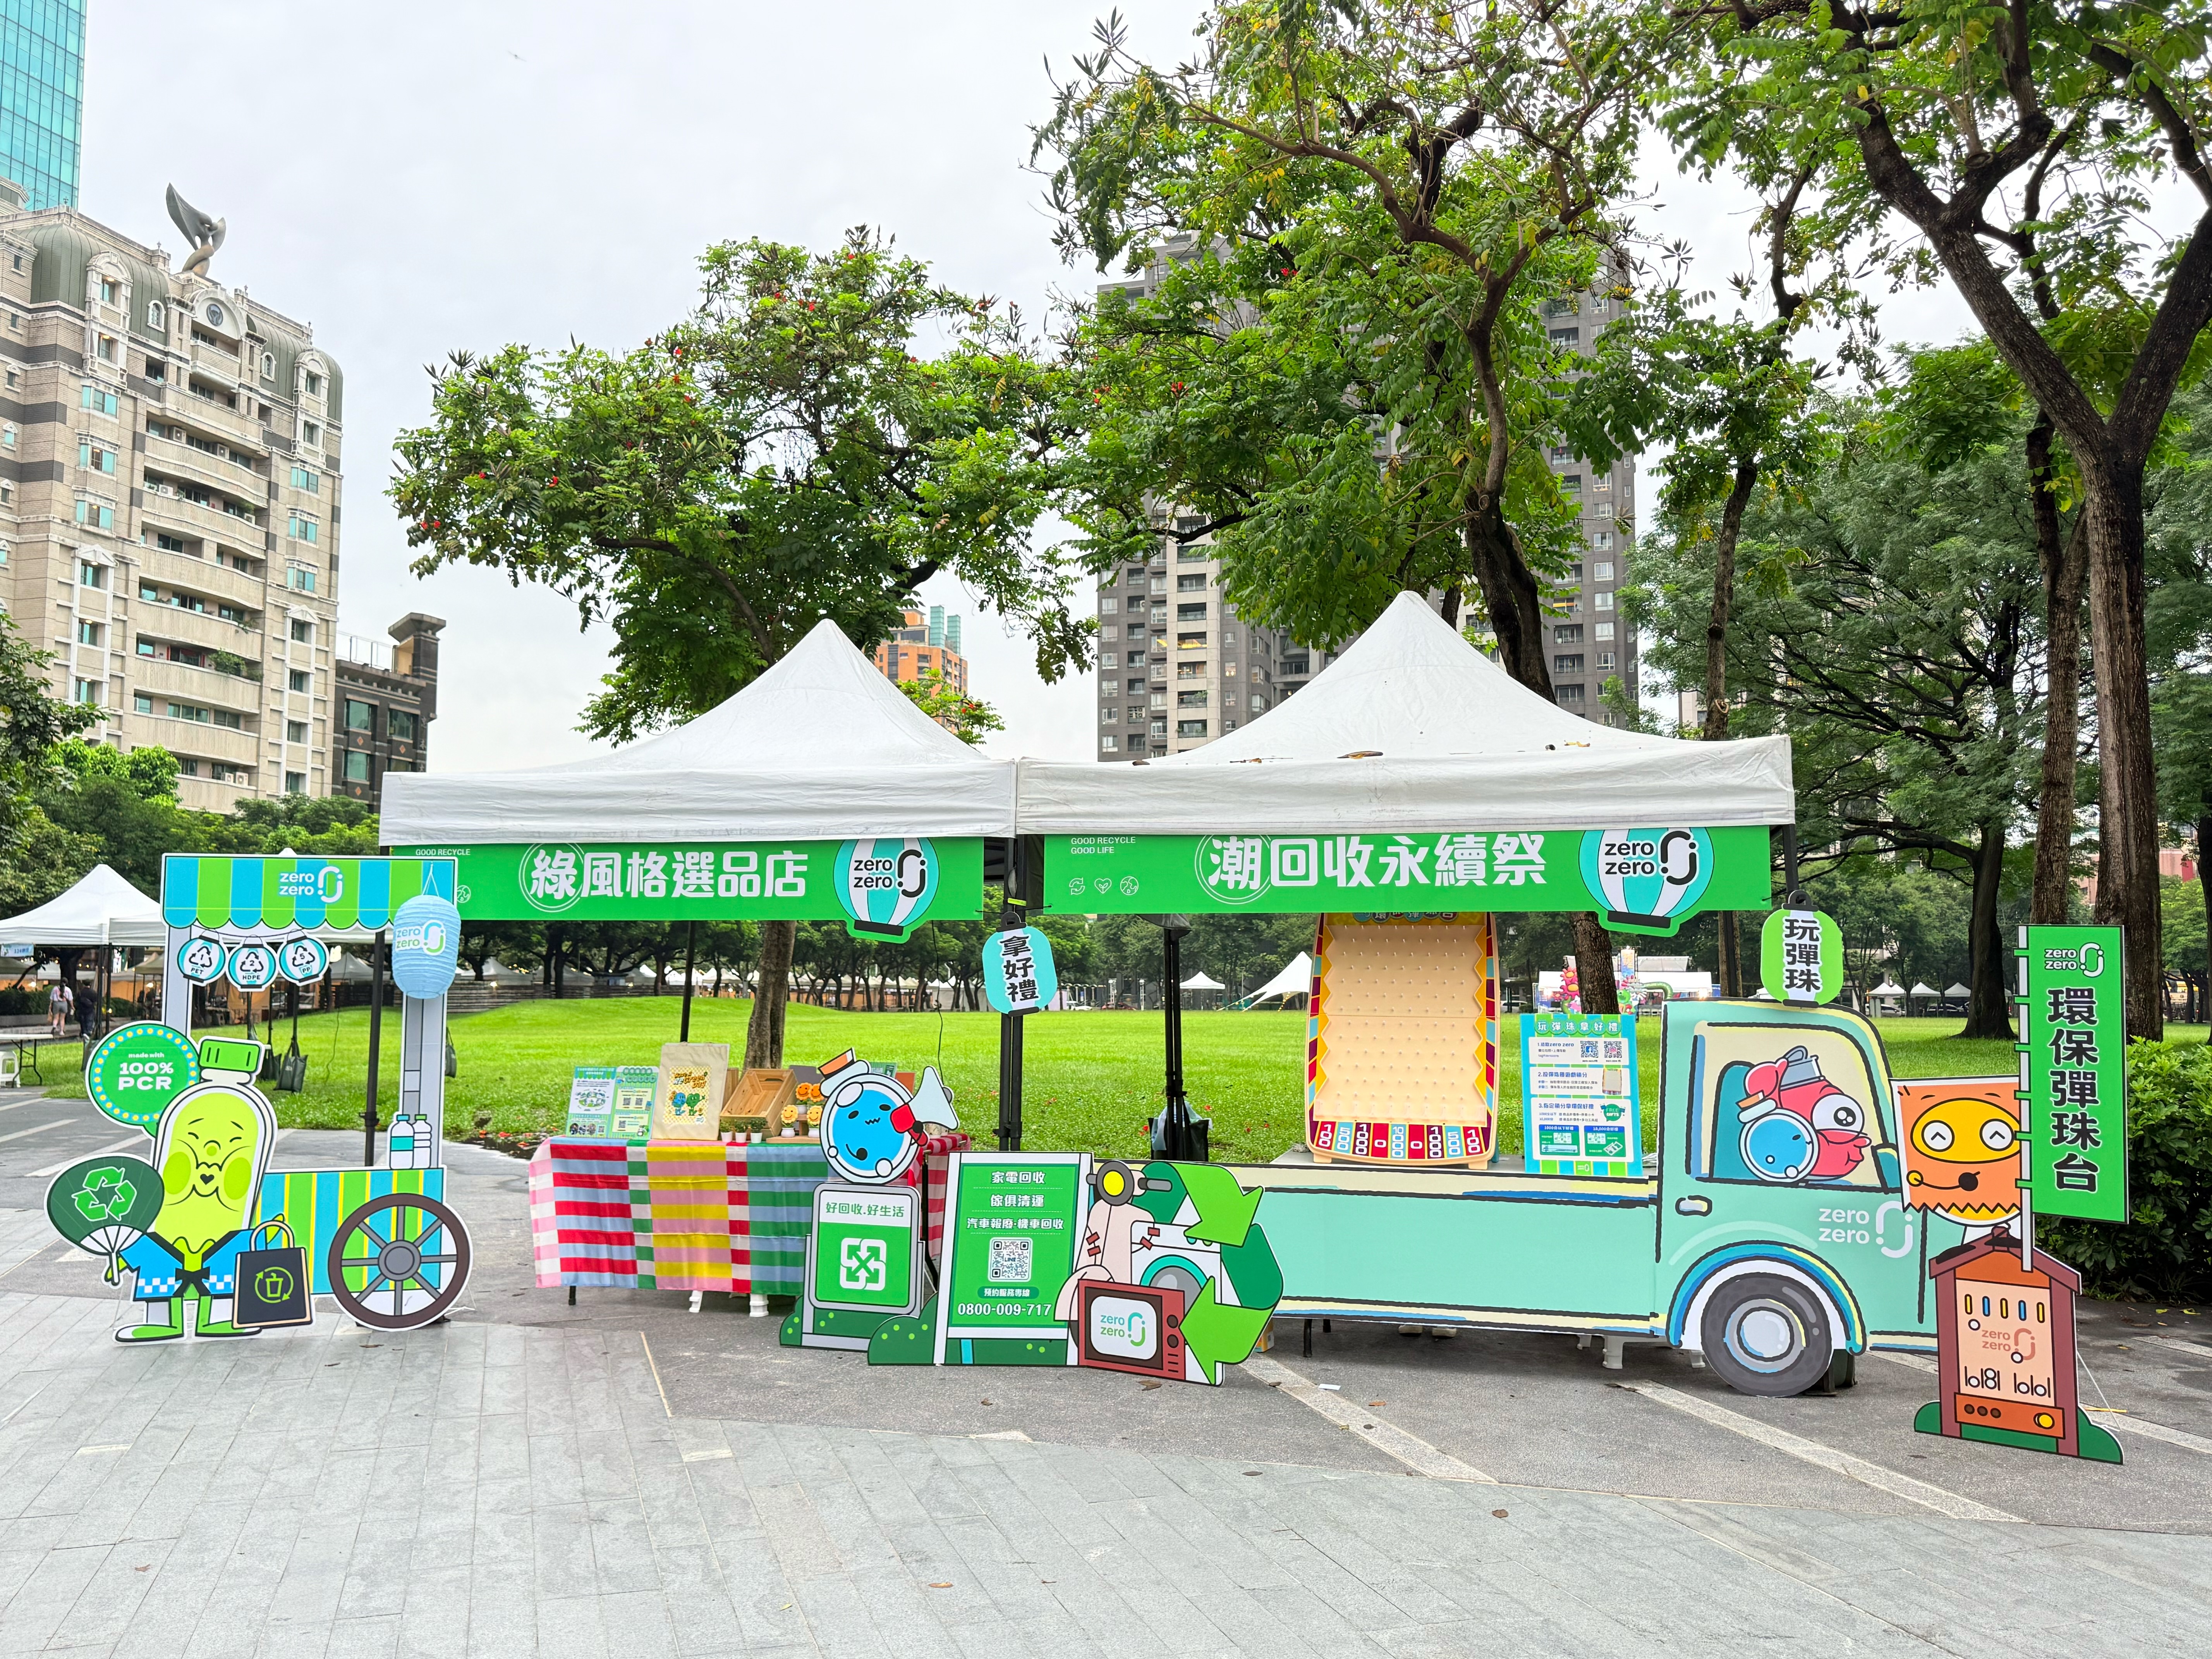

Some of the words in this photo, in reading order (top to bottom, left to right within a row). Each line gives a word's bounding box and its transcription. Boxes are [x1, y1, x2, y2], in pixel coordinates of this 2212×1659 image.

[1605, 842, 1654, 856] zero
[854, 858, 893, 871] zero
[1208, 834, 1546, 890] 潮回收永續祭
[1605, 860, 1654, 875] zero
[280, 871, 314, 883] zero
[530, 849, 808, 899] 綠風格選品店
[854, 875, 893, 888] zero
[279, 884, 314, 896] zero
[397, 927, 420, 937] zero
[396, 938, 420, 948] zero
[1785, 919, 1821, 990] 玩彈珠
[2045, 948, 2076, 958] zero
[1000, 936, 1039, 1001] 拿好禮
[2045, 960, 2076, 970] zero
[1537, 1022, 1618, 1032] 玩彈珠拿好禮
[119, 1062, 174, 1075] 100%
[118, 1076, 172, 1090] PCR
[2048, 988, 2102, 1192] 環保彈珠台
[1374, 1139, 1387, 1148] 0
[1410, 1141, 1423, 1149] 0
[991, 1171, 1046, 1184] 家電回收
[990, 1195, 1044, 1207] 傢俱清運
[826, 1202, 905, 1217] 好回收.好生活
[1819, 1208, 1870, 1224] zero
[1819, 1228, 1870, 1244] zero
[984, 1288, 1030, 1297] 預約服務專線
[957, 1303, 1052, 1316] 0800-009-717
[1100, 1314, 1125, 1326] zero
[1100, 1326, 1125, 1338] zero
[1981, 1329, 2011, 1341] zero
[1982, 1340, 2011, 1352] zero
